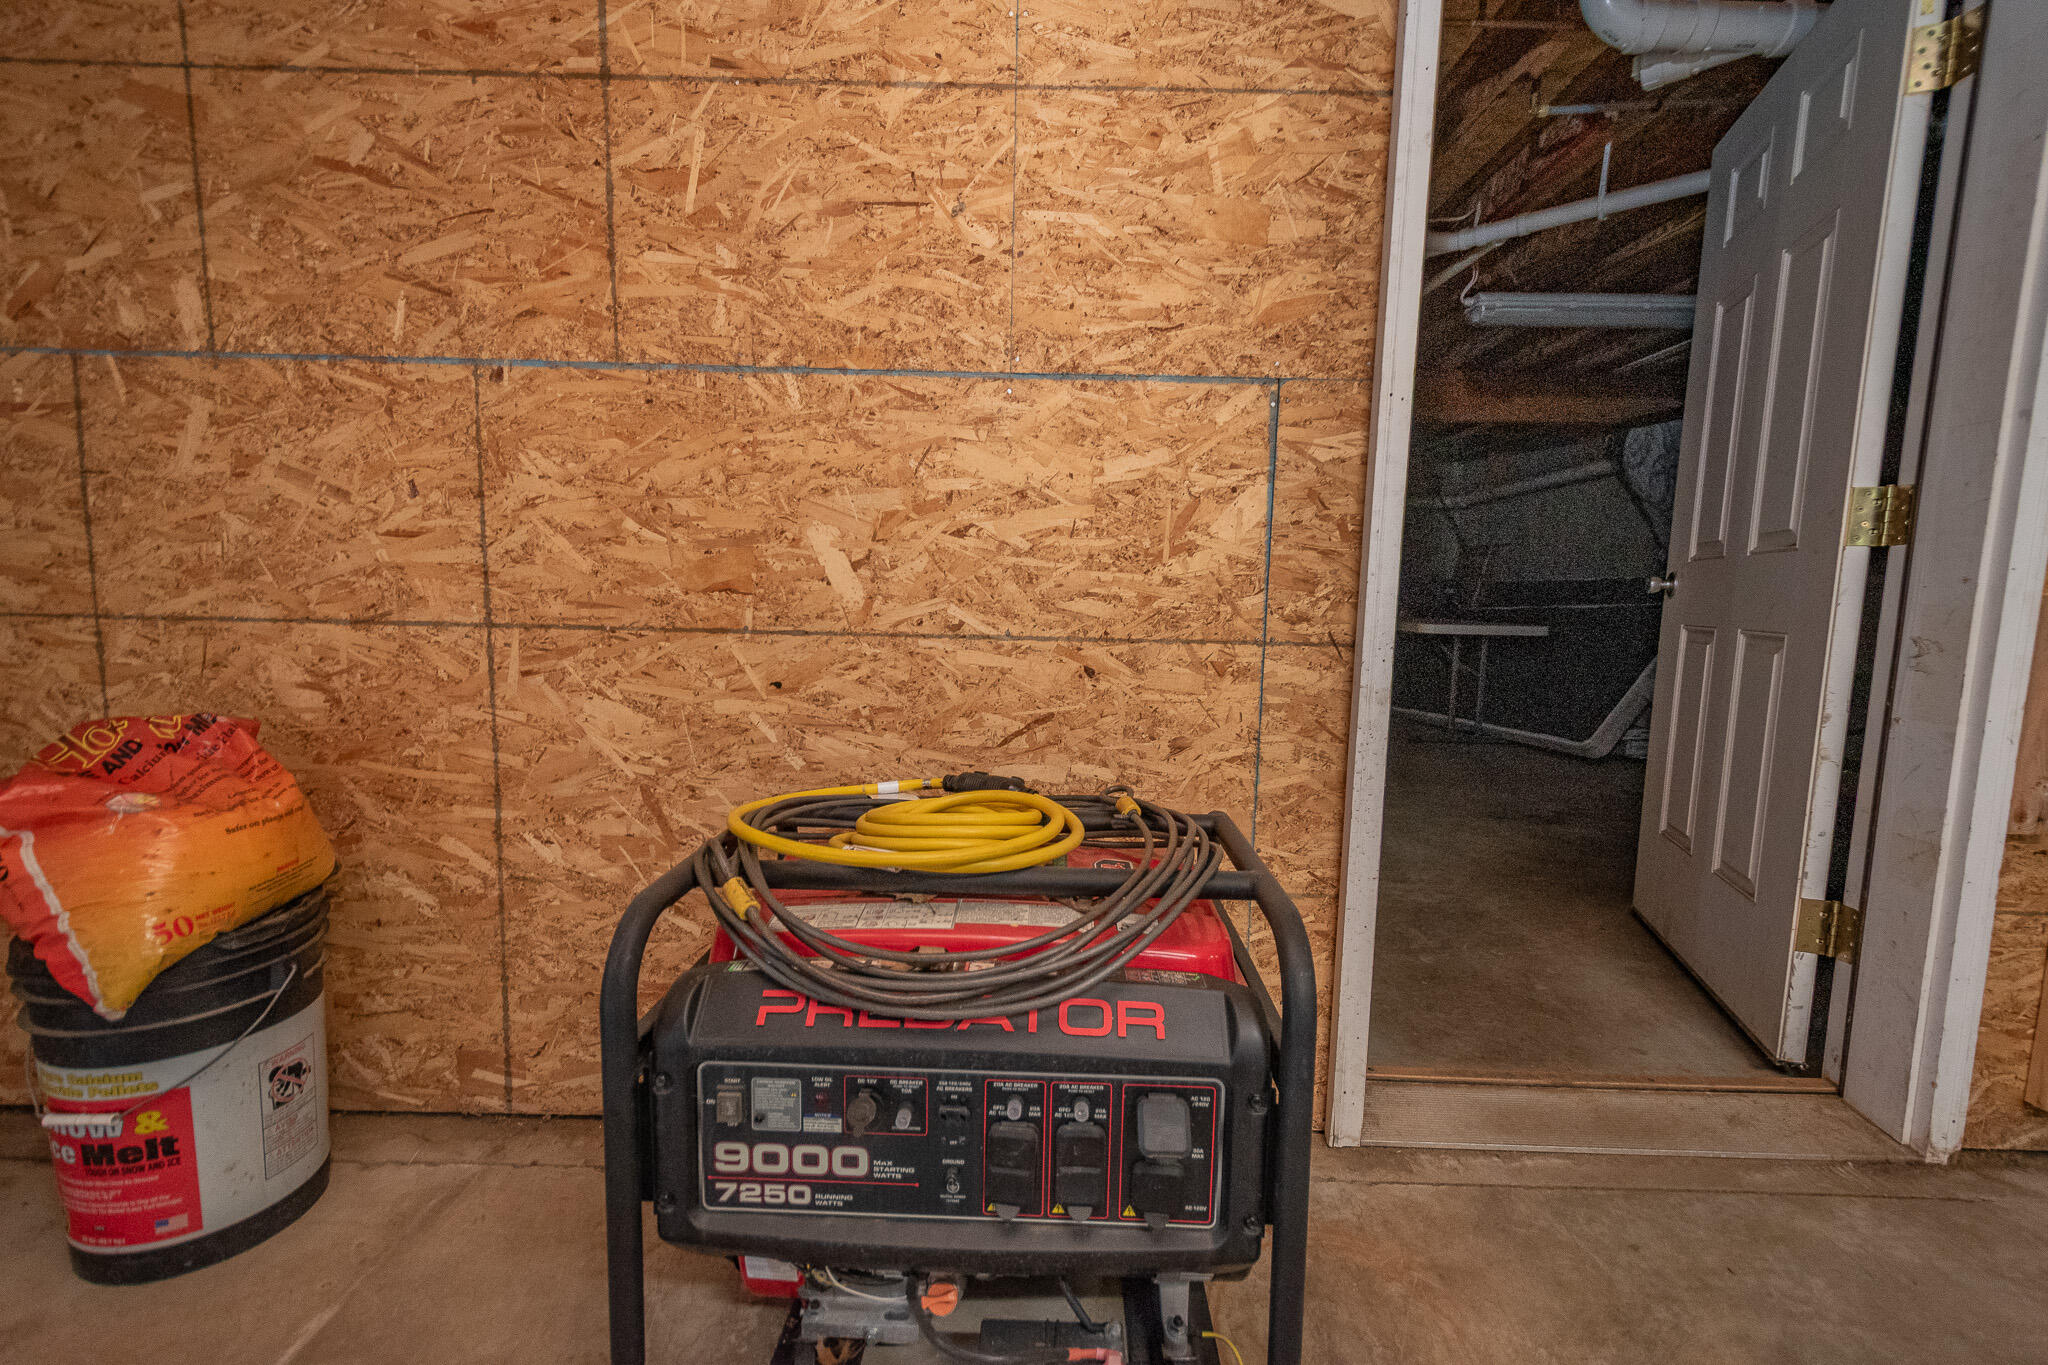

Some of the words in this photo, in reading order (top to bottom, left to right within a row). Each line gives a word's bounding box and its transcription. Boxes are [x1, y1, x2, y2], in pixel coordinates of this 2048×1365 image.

[102, 739, 143, 775] AND
[152, 916, 194, 946] 50
[134, 1110, 169, 1135] &
[80, 1136, 180, 1167] Melt
[714, 1141, 870, 1177] 9000
[873, 1166, 915, 1174] STARTING
[873, 1172, 902, 1180] WATTS
[715, 1182, 812, 1205] 7250
[814, 1193, 853, 1201] RUNNING
